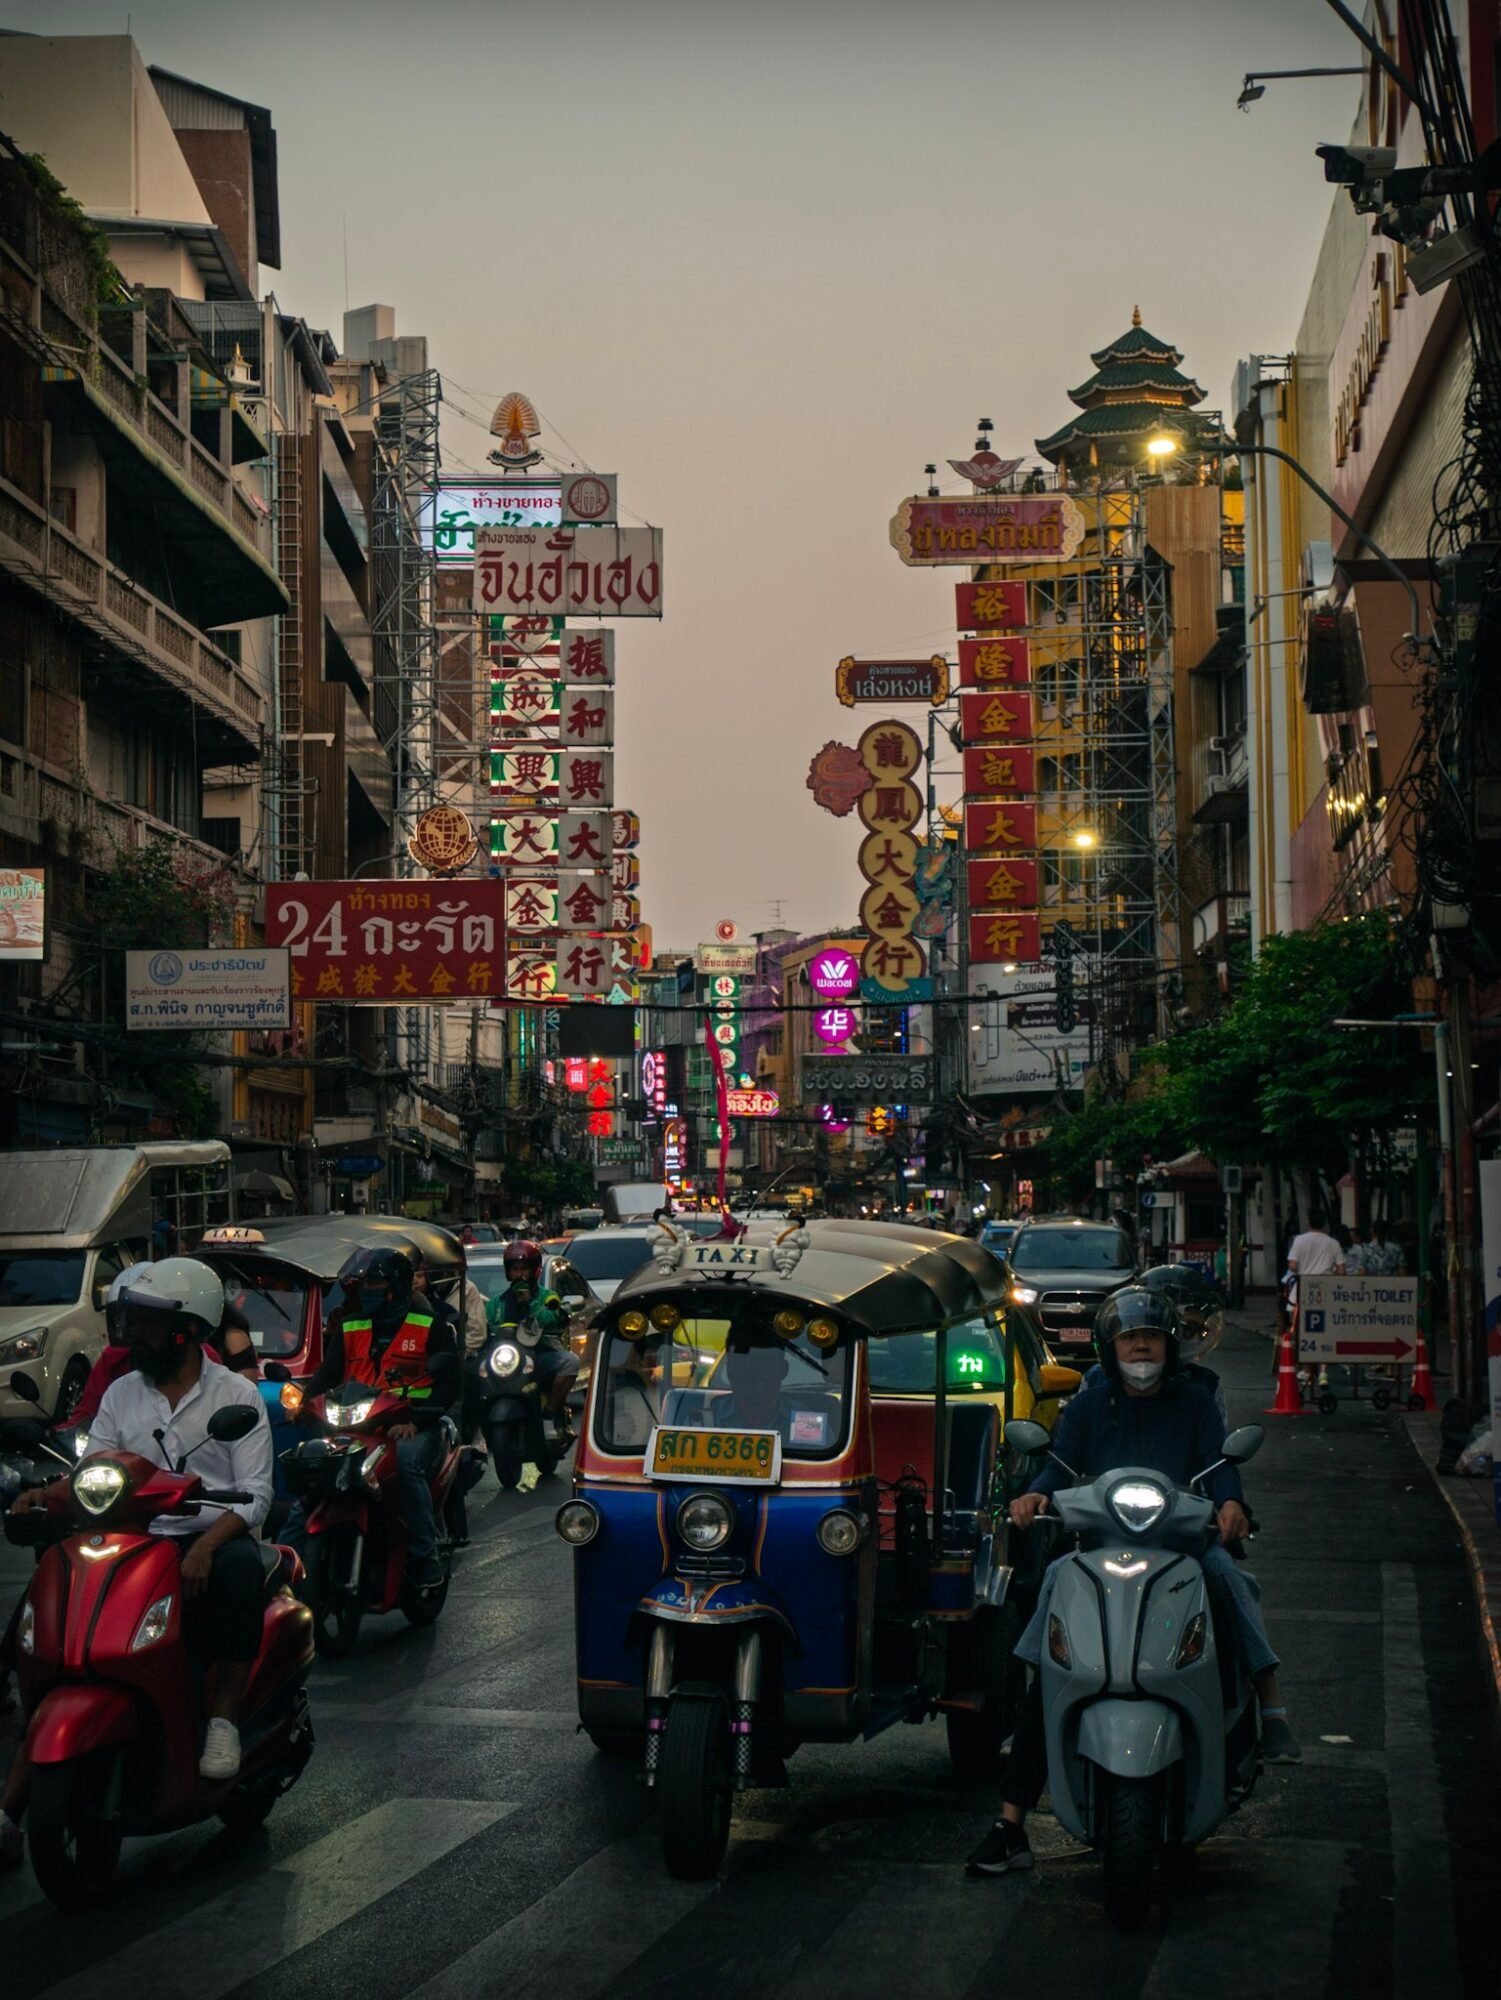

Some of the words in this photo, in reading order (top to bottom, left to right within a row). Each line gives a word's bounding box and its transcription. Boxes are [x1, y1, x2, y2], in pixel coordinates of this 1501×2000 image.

[472, 492, 562, 509] ห้างขายทอง
[477, 532, 537, 545] ห้างขายทอง
[478, 531, 661, 604] จินฮั้วเฮง
[562, 635, 609, 988] 振和興大金行
[871, 731, 915, 979] 龍鳳大金行
[348, 888, 432, 909] ห้างทอง
[278, 900, 348, 957] 24
[360, 900, 495, 956] กะรัต
[189, 958, 267, 972] ประชาธิปัตย์
[817, 979, 852, 988] Wacoal
[213, 1229, 249, 1238] TAXI
[695, 1247, 759, 1265] TAXI
[1332, 1282, 1371, 1303] ห้องน้ำ
[1373, 1290, 1414, 1303] TOILET
[1311, 1314, 1321, 1330] P
[402, 1340, 416, 1351] 65
[1301, 1341, 1316, 1352] 24
[707, 1435, 770, 1461] 6366
